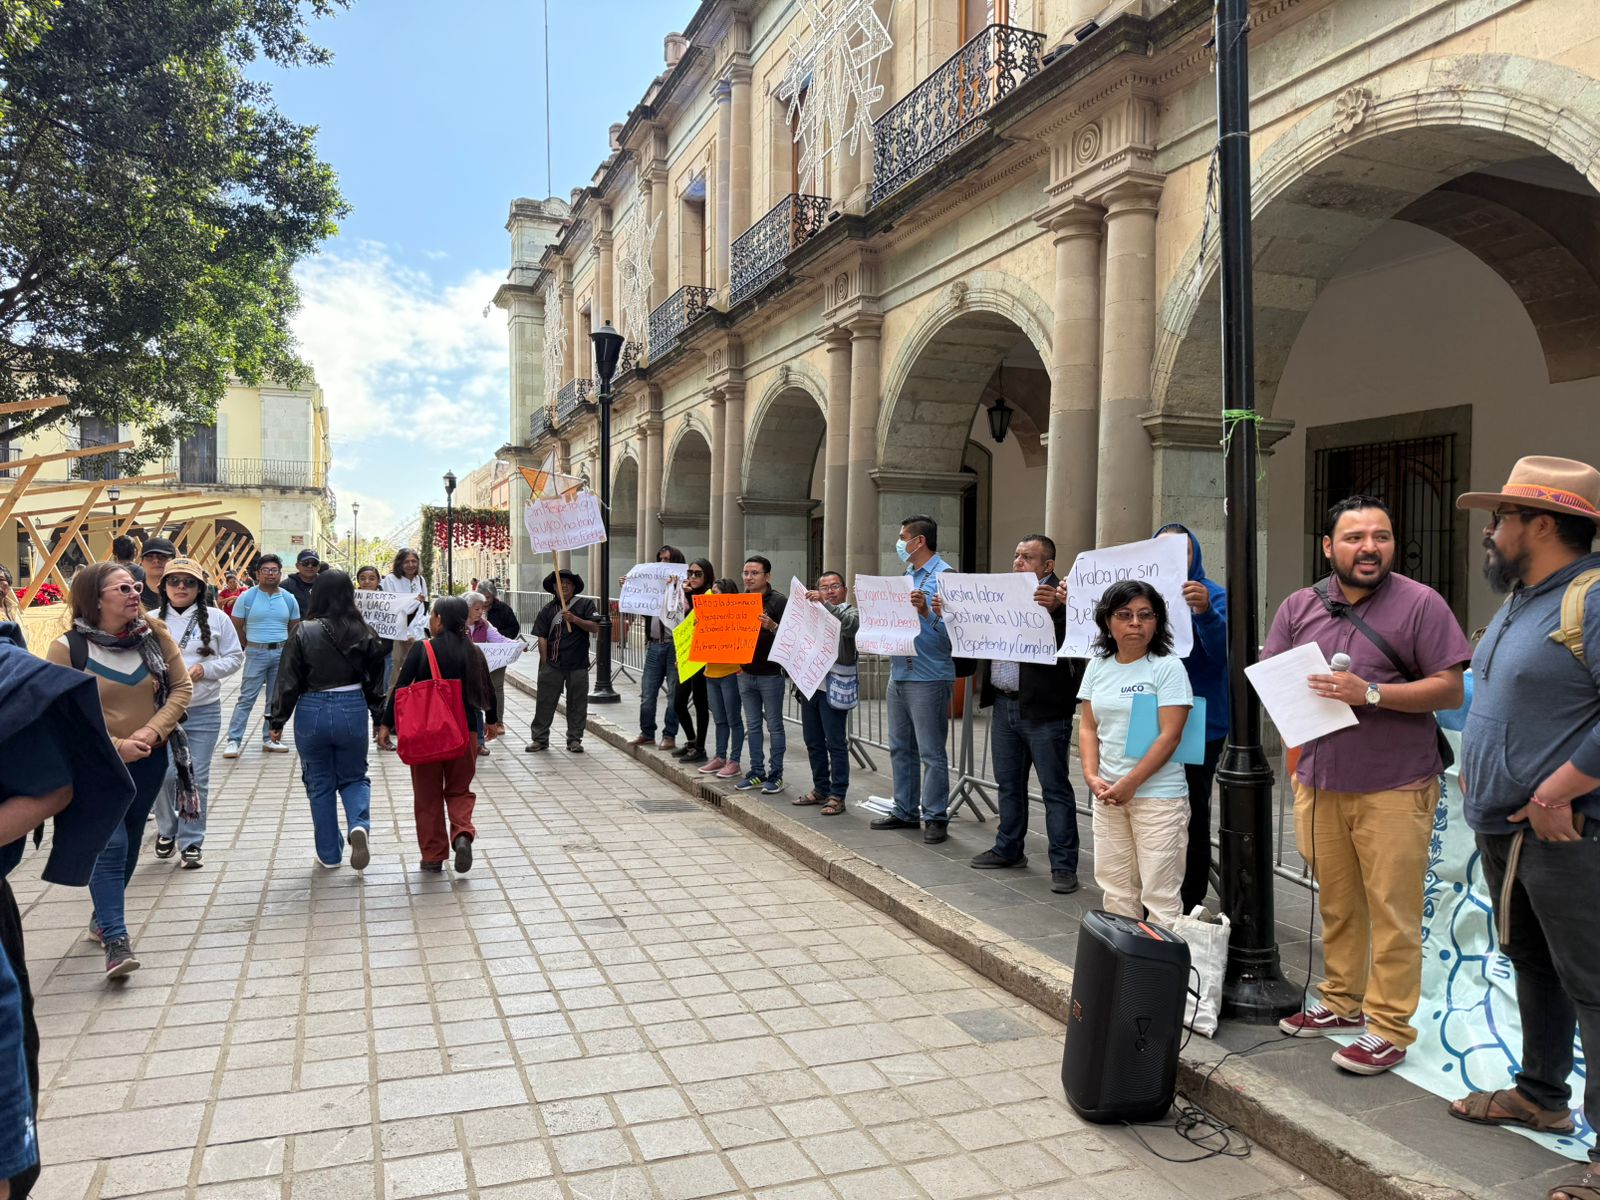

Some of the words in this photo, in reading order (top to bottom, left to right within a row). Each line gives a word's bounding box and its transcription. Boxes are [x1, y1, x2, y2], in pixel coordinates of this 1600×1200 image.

[1075, 557, 1133, 587] Trabajar
[1138, 562, 1159, 578] sin
[938, 579, 976, 603] Nuestra
[367, 601, 390, 611] UACO
[1007, 609, 1045, 629] UACO
[1120, 684, 1144, 693] UACO
